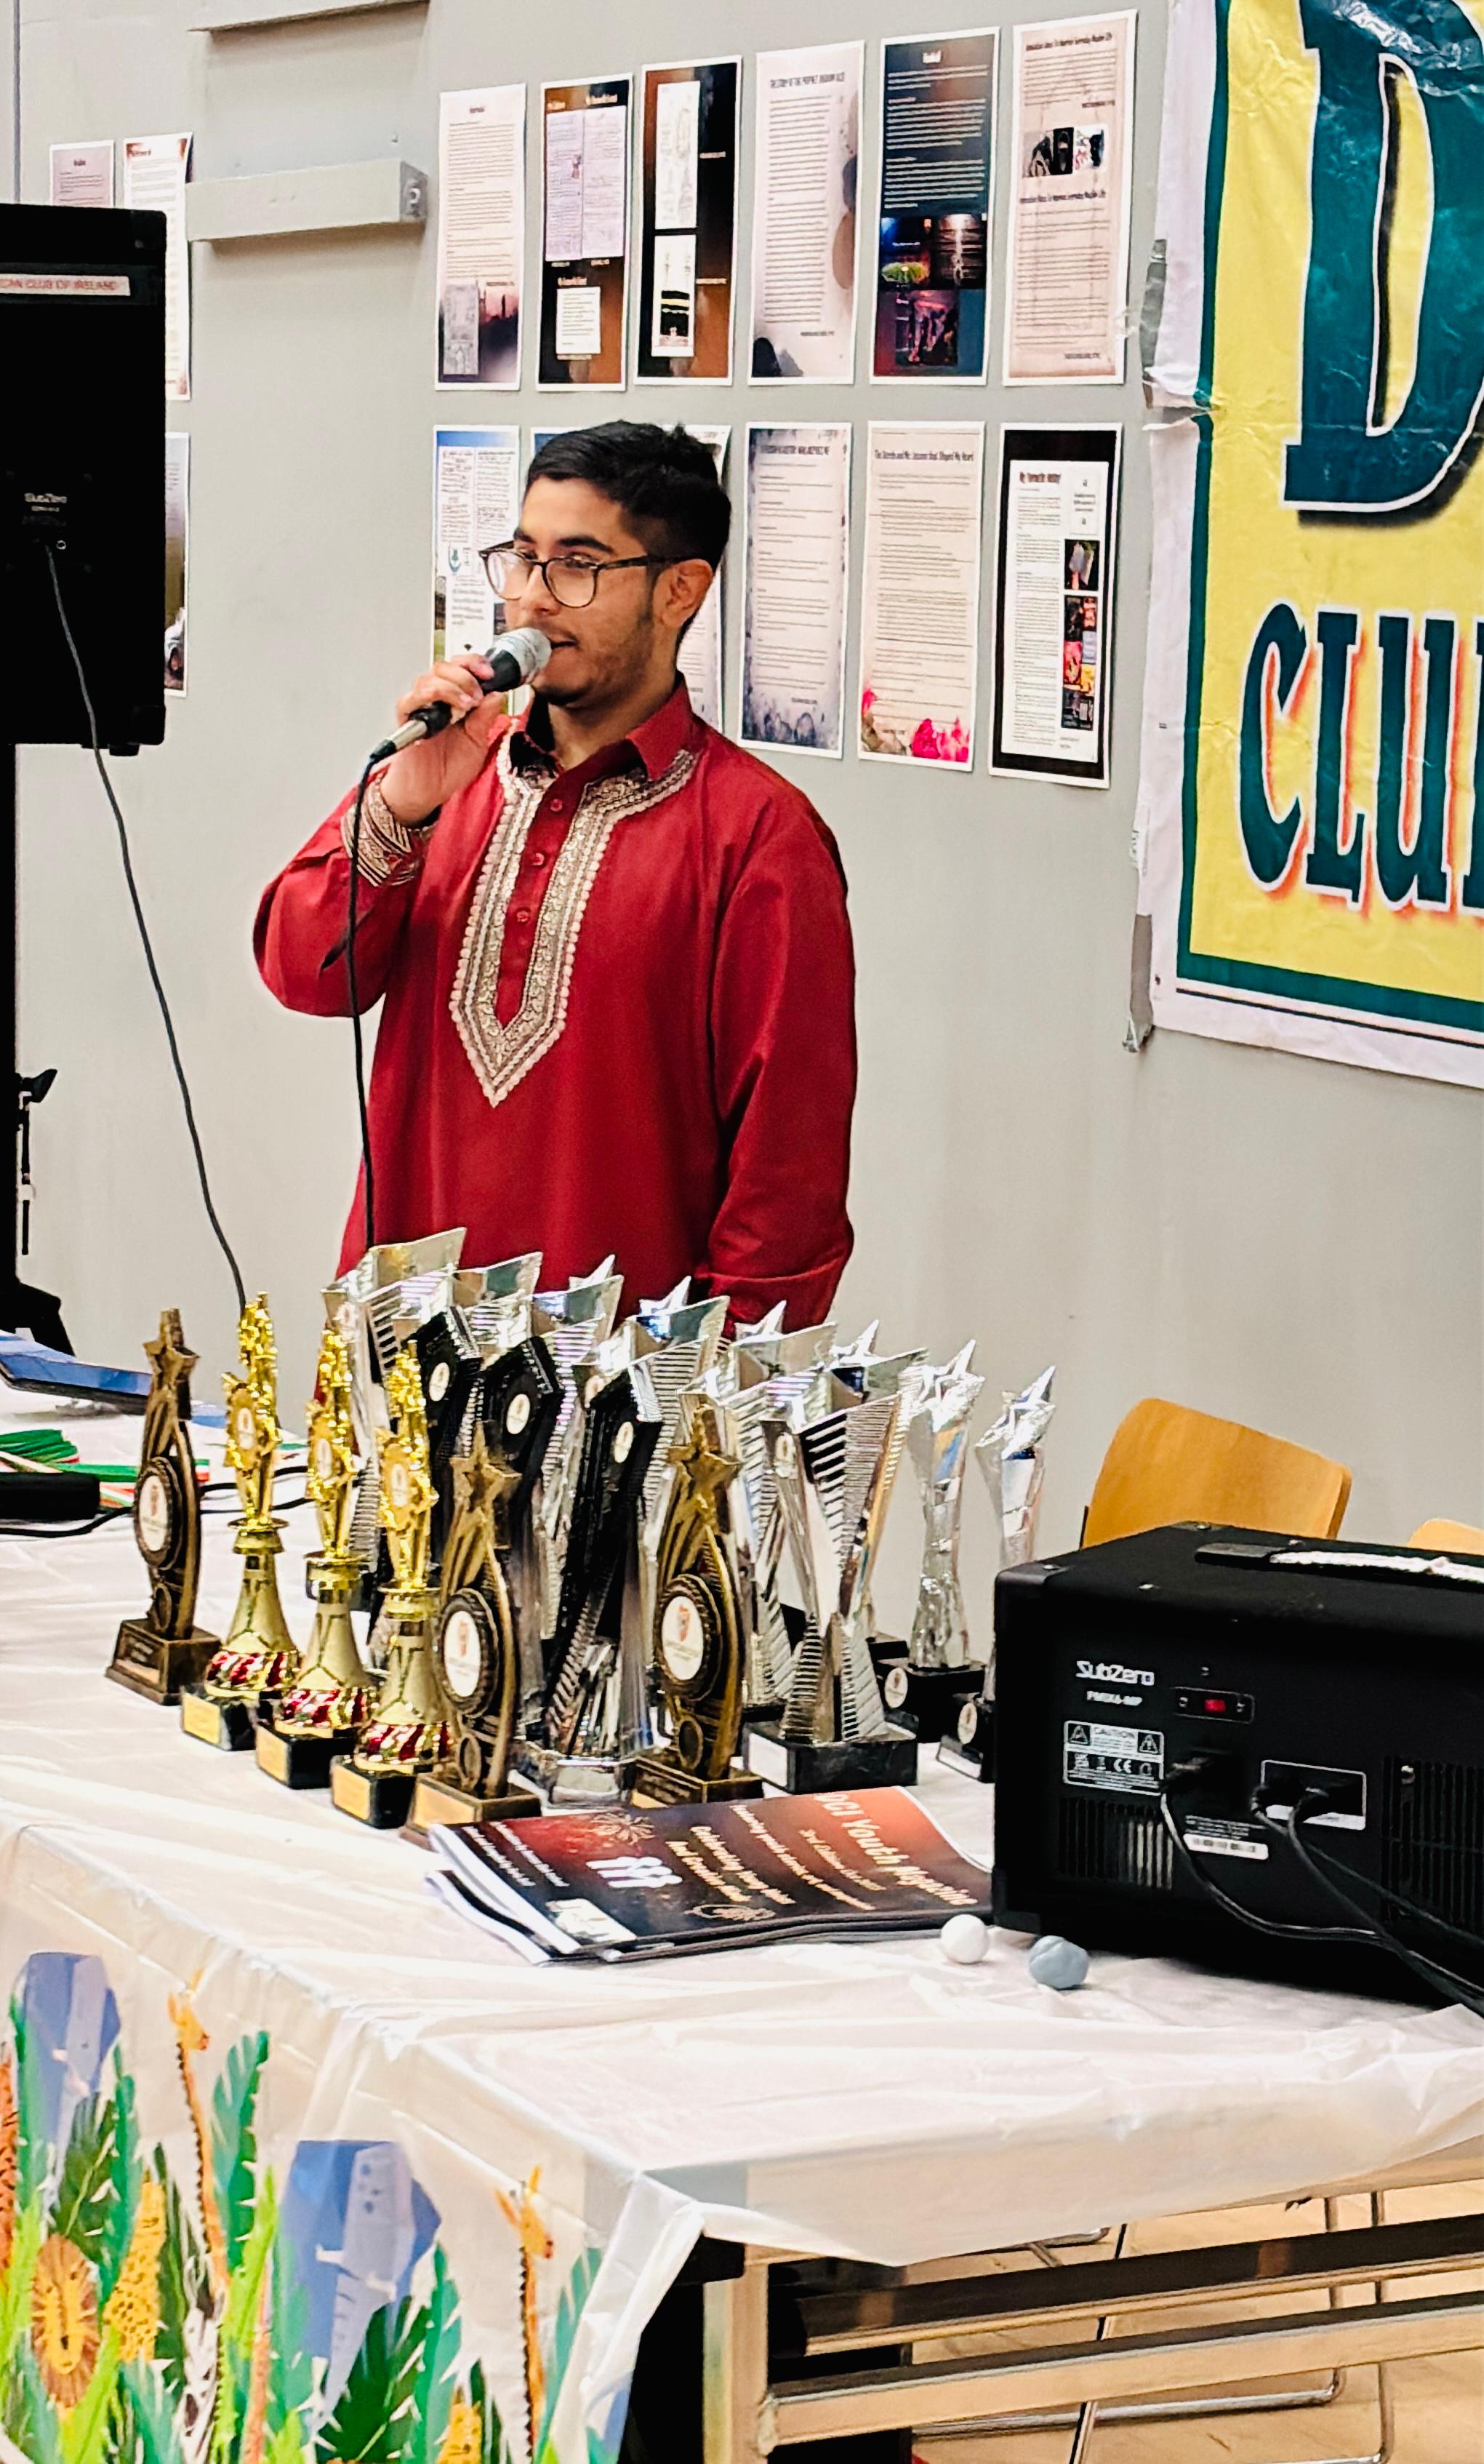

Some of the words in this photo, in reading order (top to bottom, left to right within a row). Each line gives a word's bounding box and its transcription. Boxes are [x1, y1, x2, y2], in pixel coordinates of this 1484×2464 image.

[1076, 1660, 1155, 1687] SubZero
[1113, 1759, 1132, 1774] CE
[665, 1841, 699, 1857] And
[689, 1825, 745, 1871] Celebrating
[841, 1819, 910, 1865] Youth
[883, 1866, 979, 1905] Magazine
[681, 1857, 726, 1886] Creative
